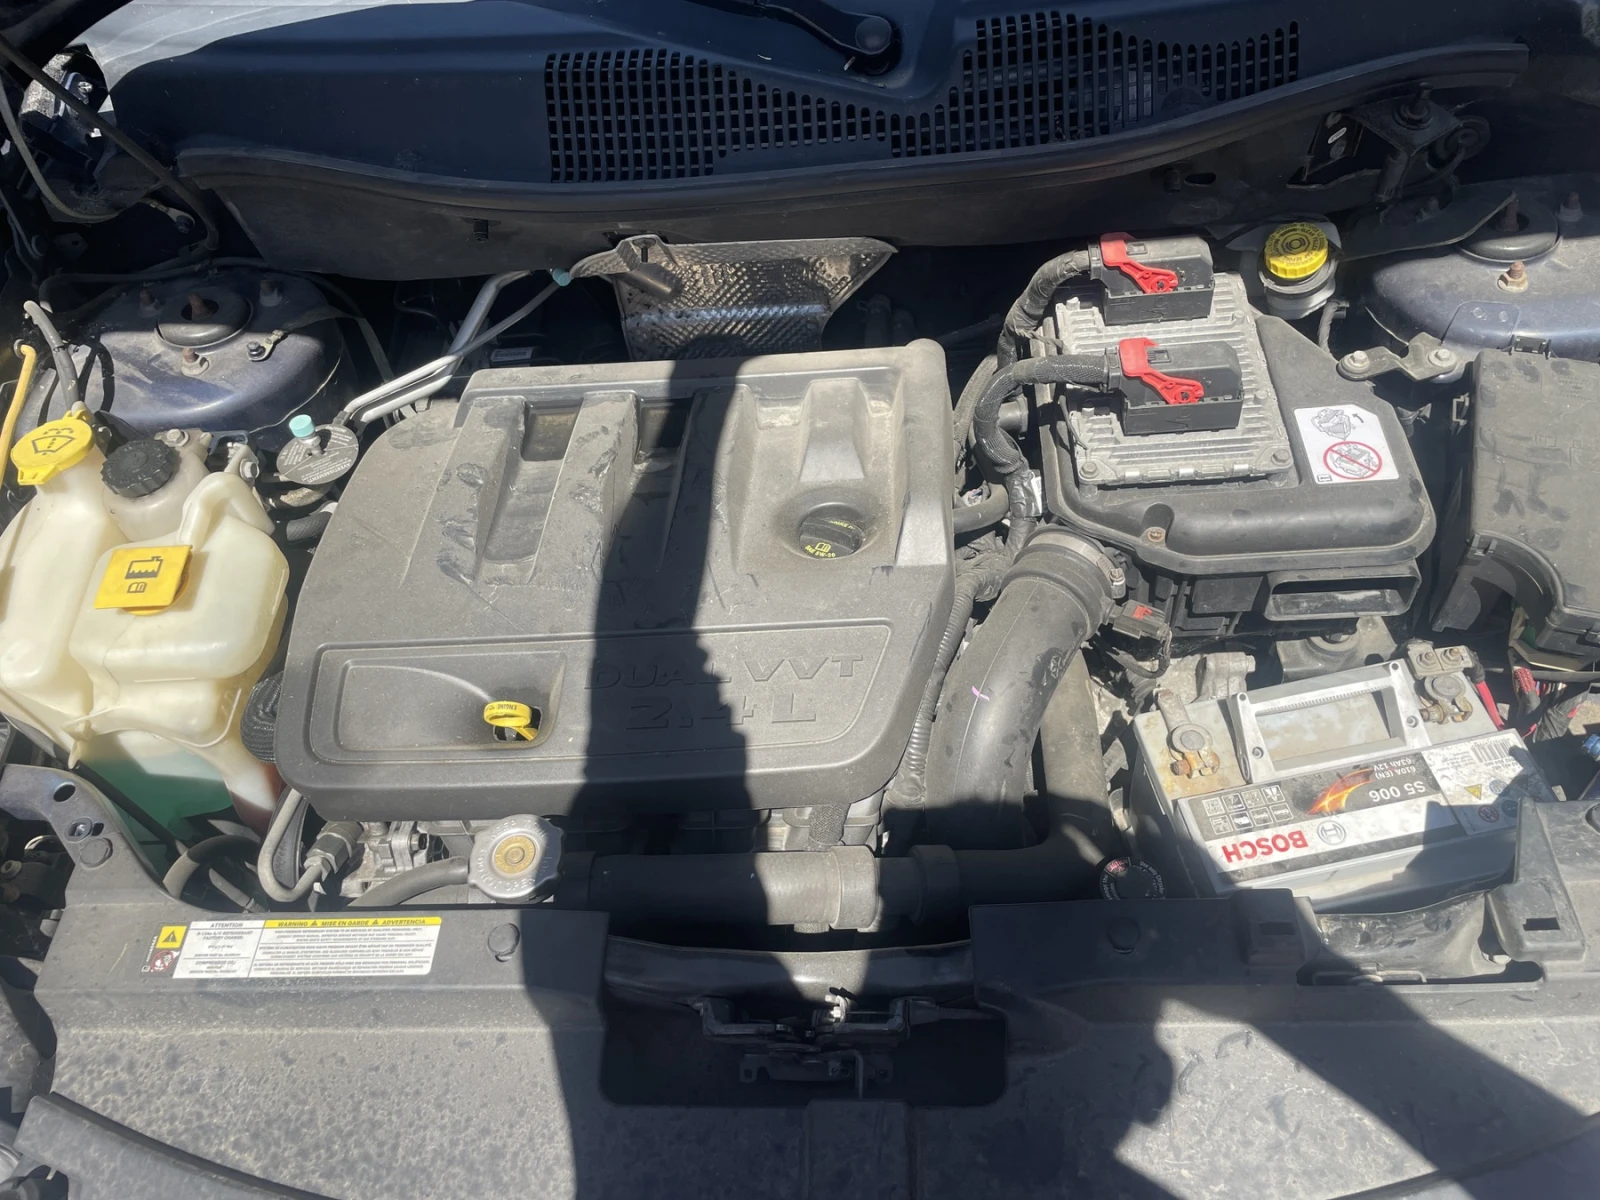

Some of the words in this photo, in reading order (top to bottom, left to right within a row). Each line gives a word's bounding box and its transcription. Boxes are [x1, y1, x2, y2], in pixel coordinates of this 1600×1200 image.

[805, 544, 816, 554] SAE
[584, 662, 732, 690] DUAL
[744, 654, 864, 682] VVT
[1368, 784, 1402, 803] 006
[1406, 780, 1427, 796] S5
[1221, 830, 1308, 863] BOSCH
